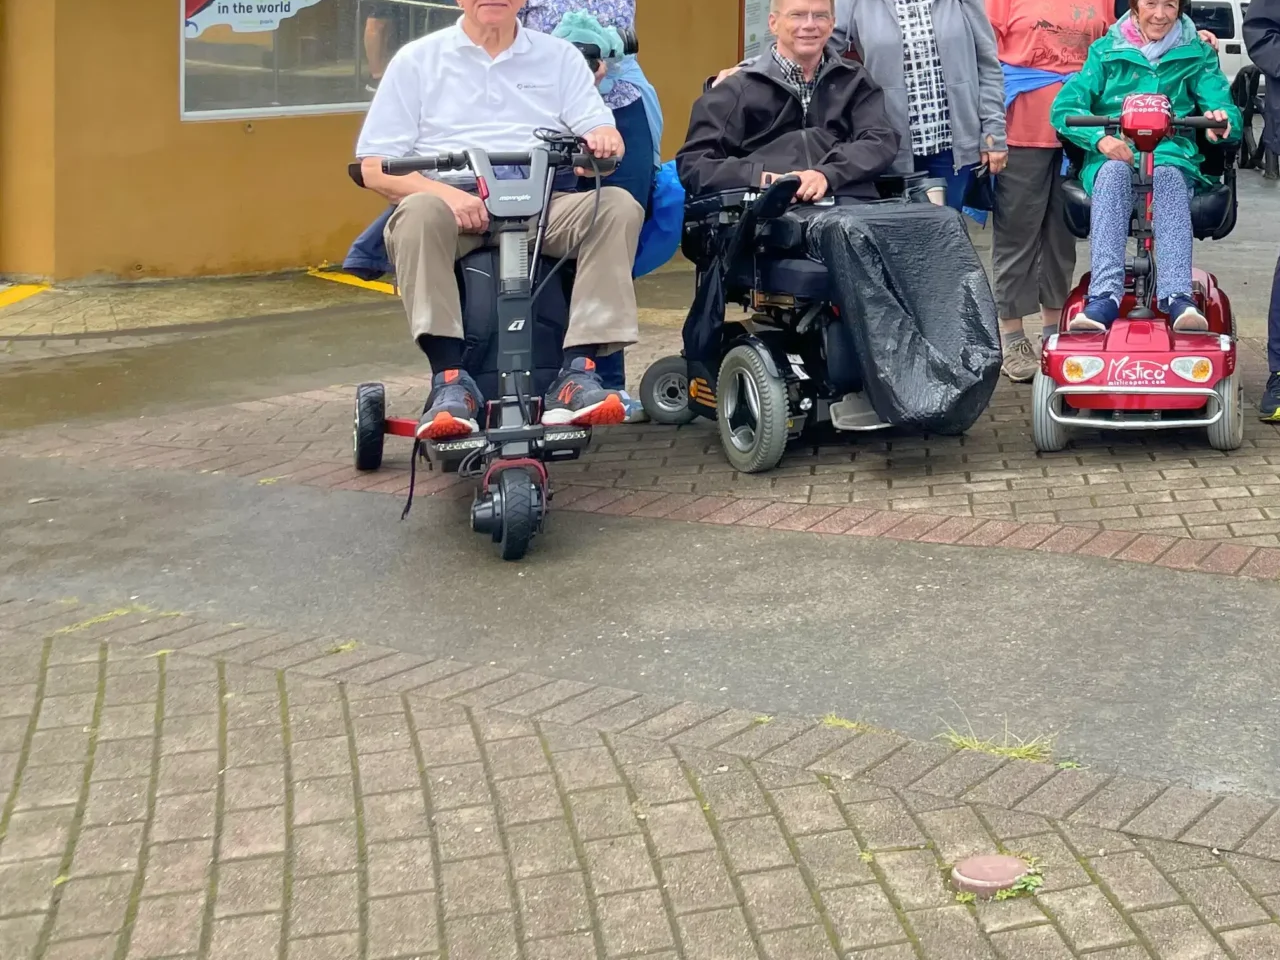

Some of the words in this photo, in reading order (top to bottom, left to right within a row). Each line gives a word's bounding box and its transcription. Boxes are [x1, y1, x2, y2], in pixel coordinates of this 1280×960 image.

[217, 2, 229, 14] in
[233, 3, 253, 14] the
[256, 1, 291, 14] world
[1107, 356, 1168, 381] Mistico
